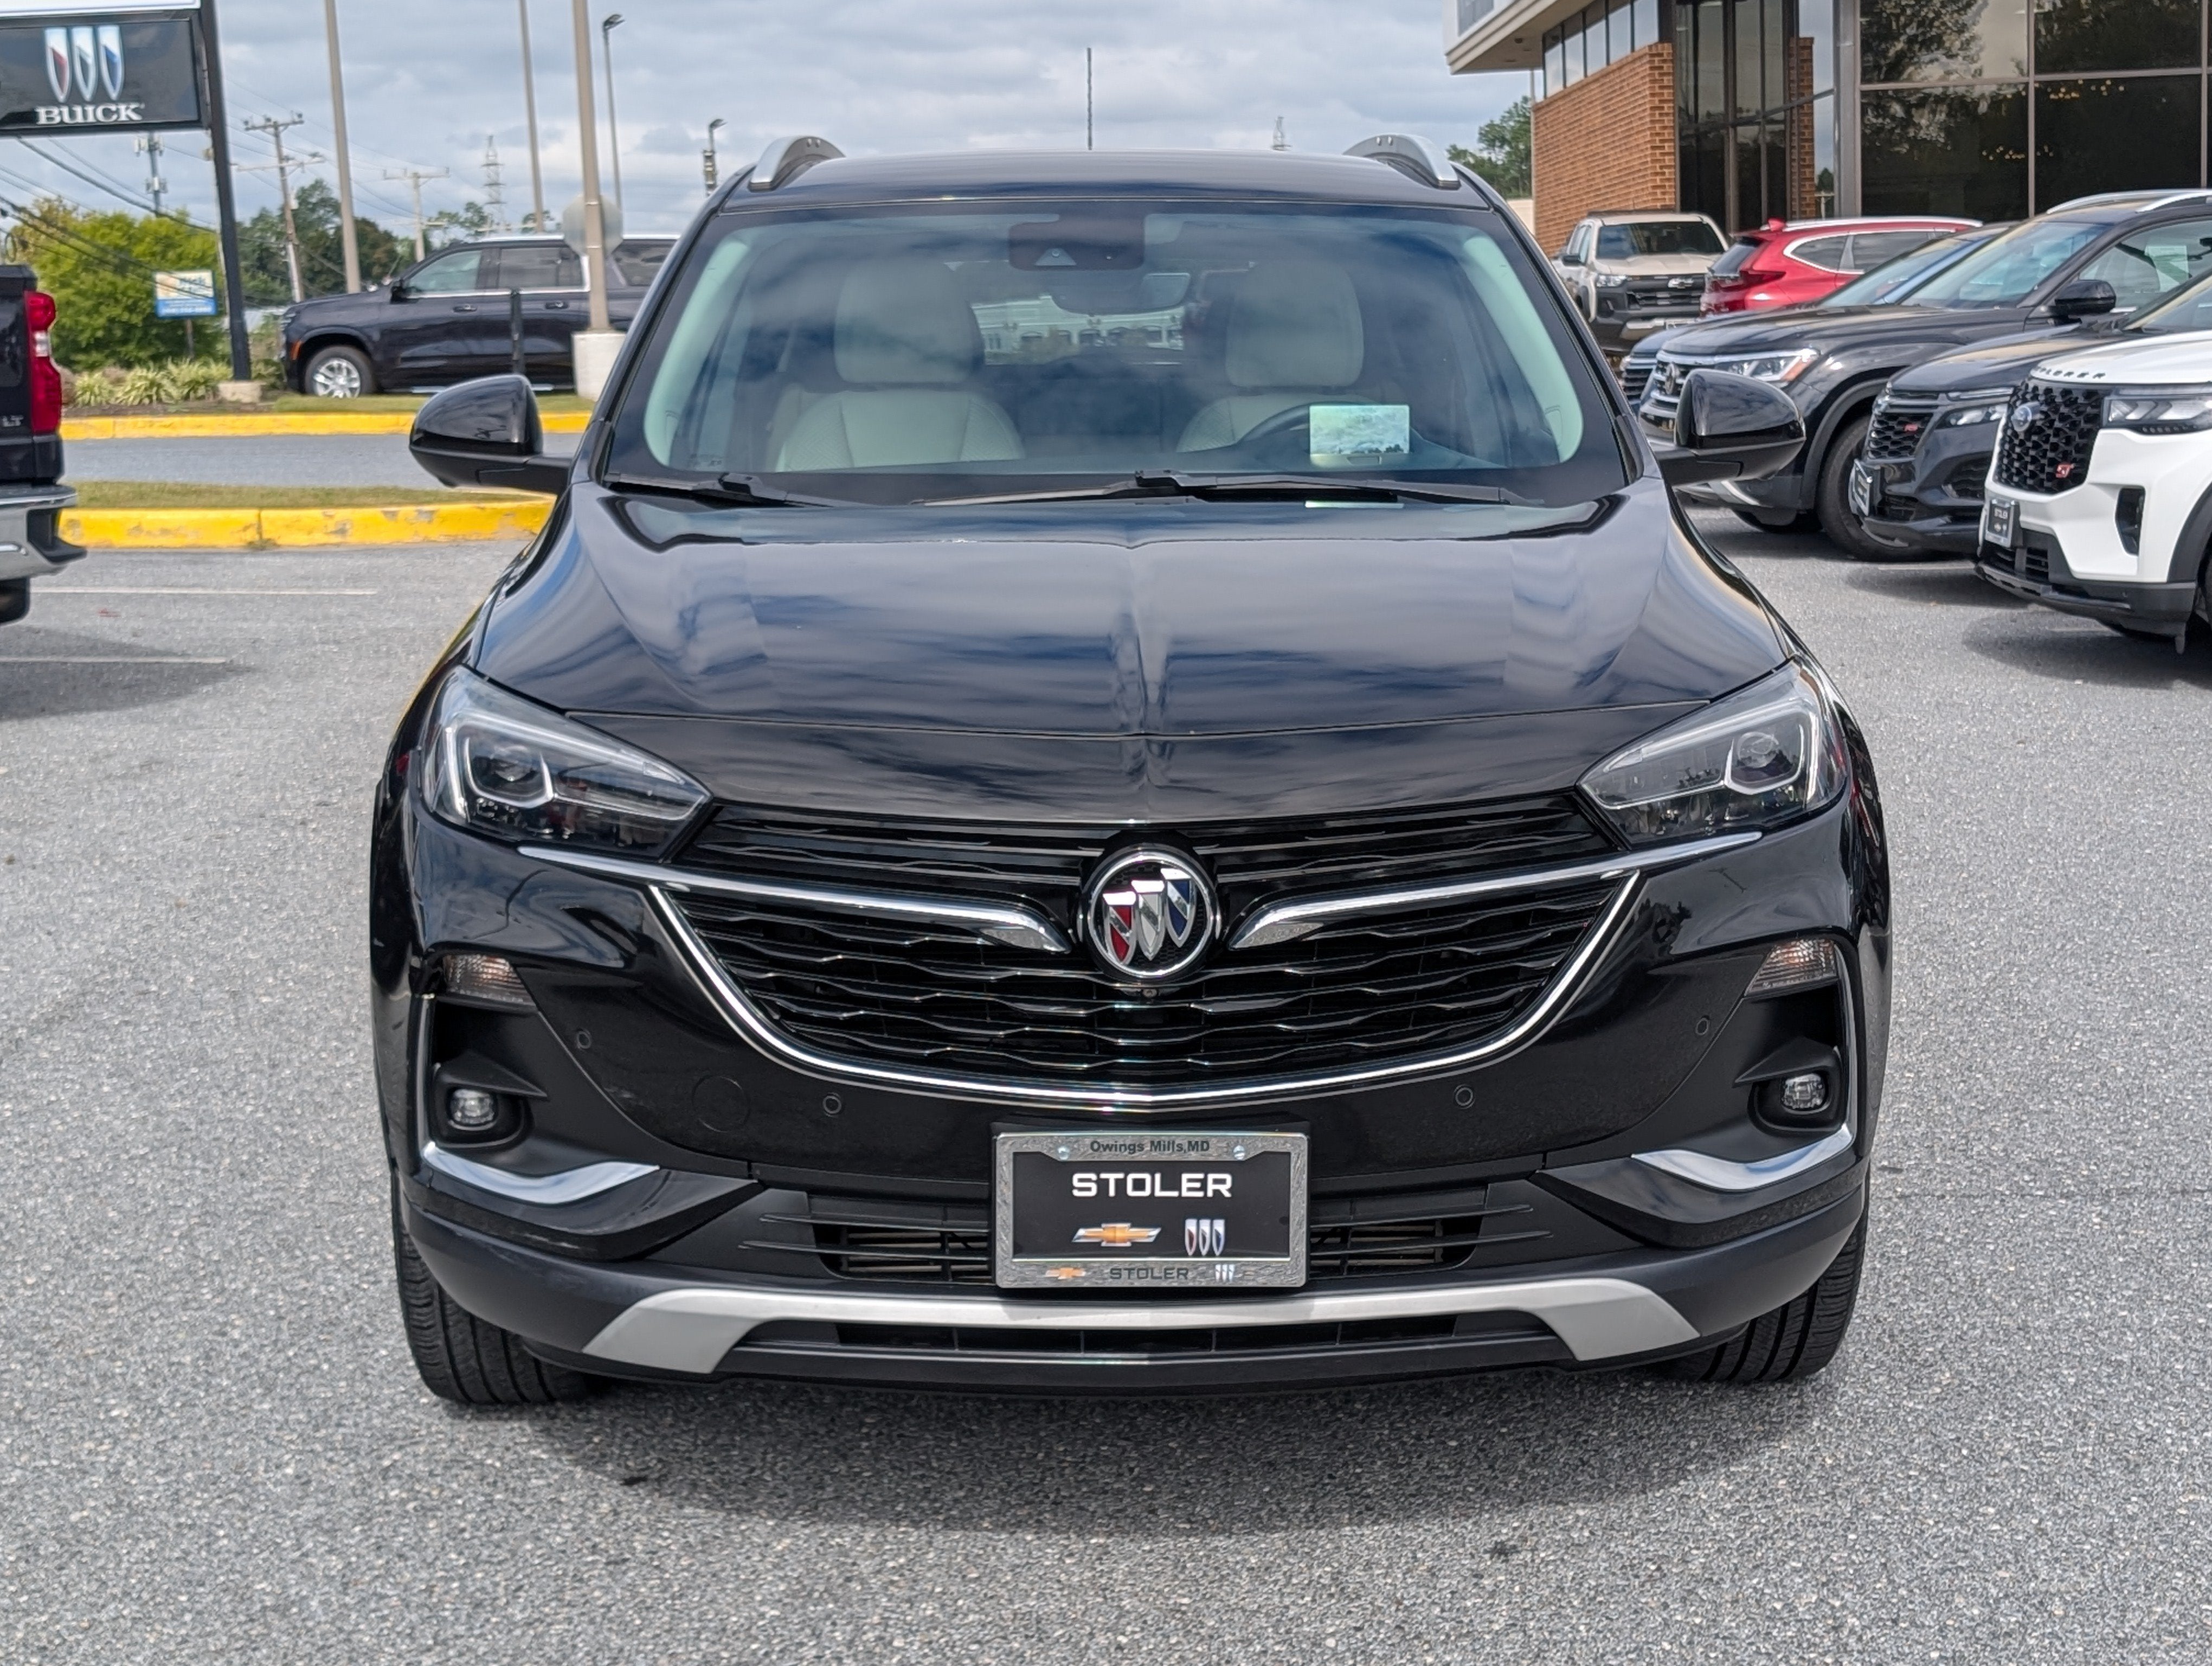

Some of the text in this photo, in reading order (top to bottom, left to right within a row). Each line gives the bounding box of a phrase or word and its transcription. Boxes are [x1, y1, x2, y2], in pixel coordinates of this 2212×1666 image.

[34, 102, 143, 125] BUICK
[1090, 1140, 1144, 1155] Owings
[1072, 1172, 1232, 1197] STOLER
[1109, 1267, 1189, 1280] STOLER
